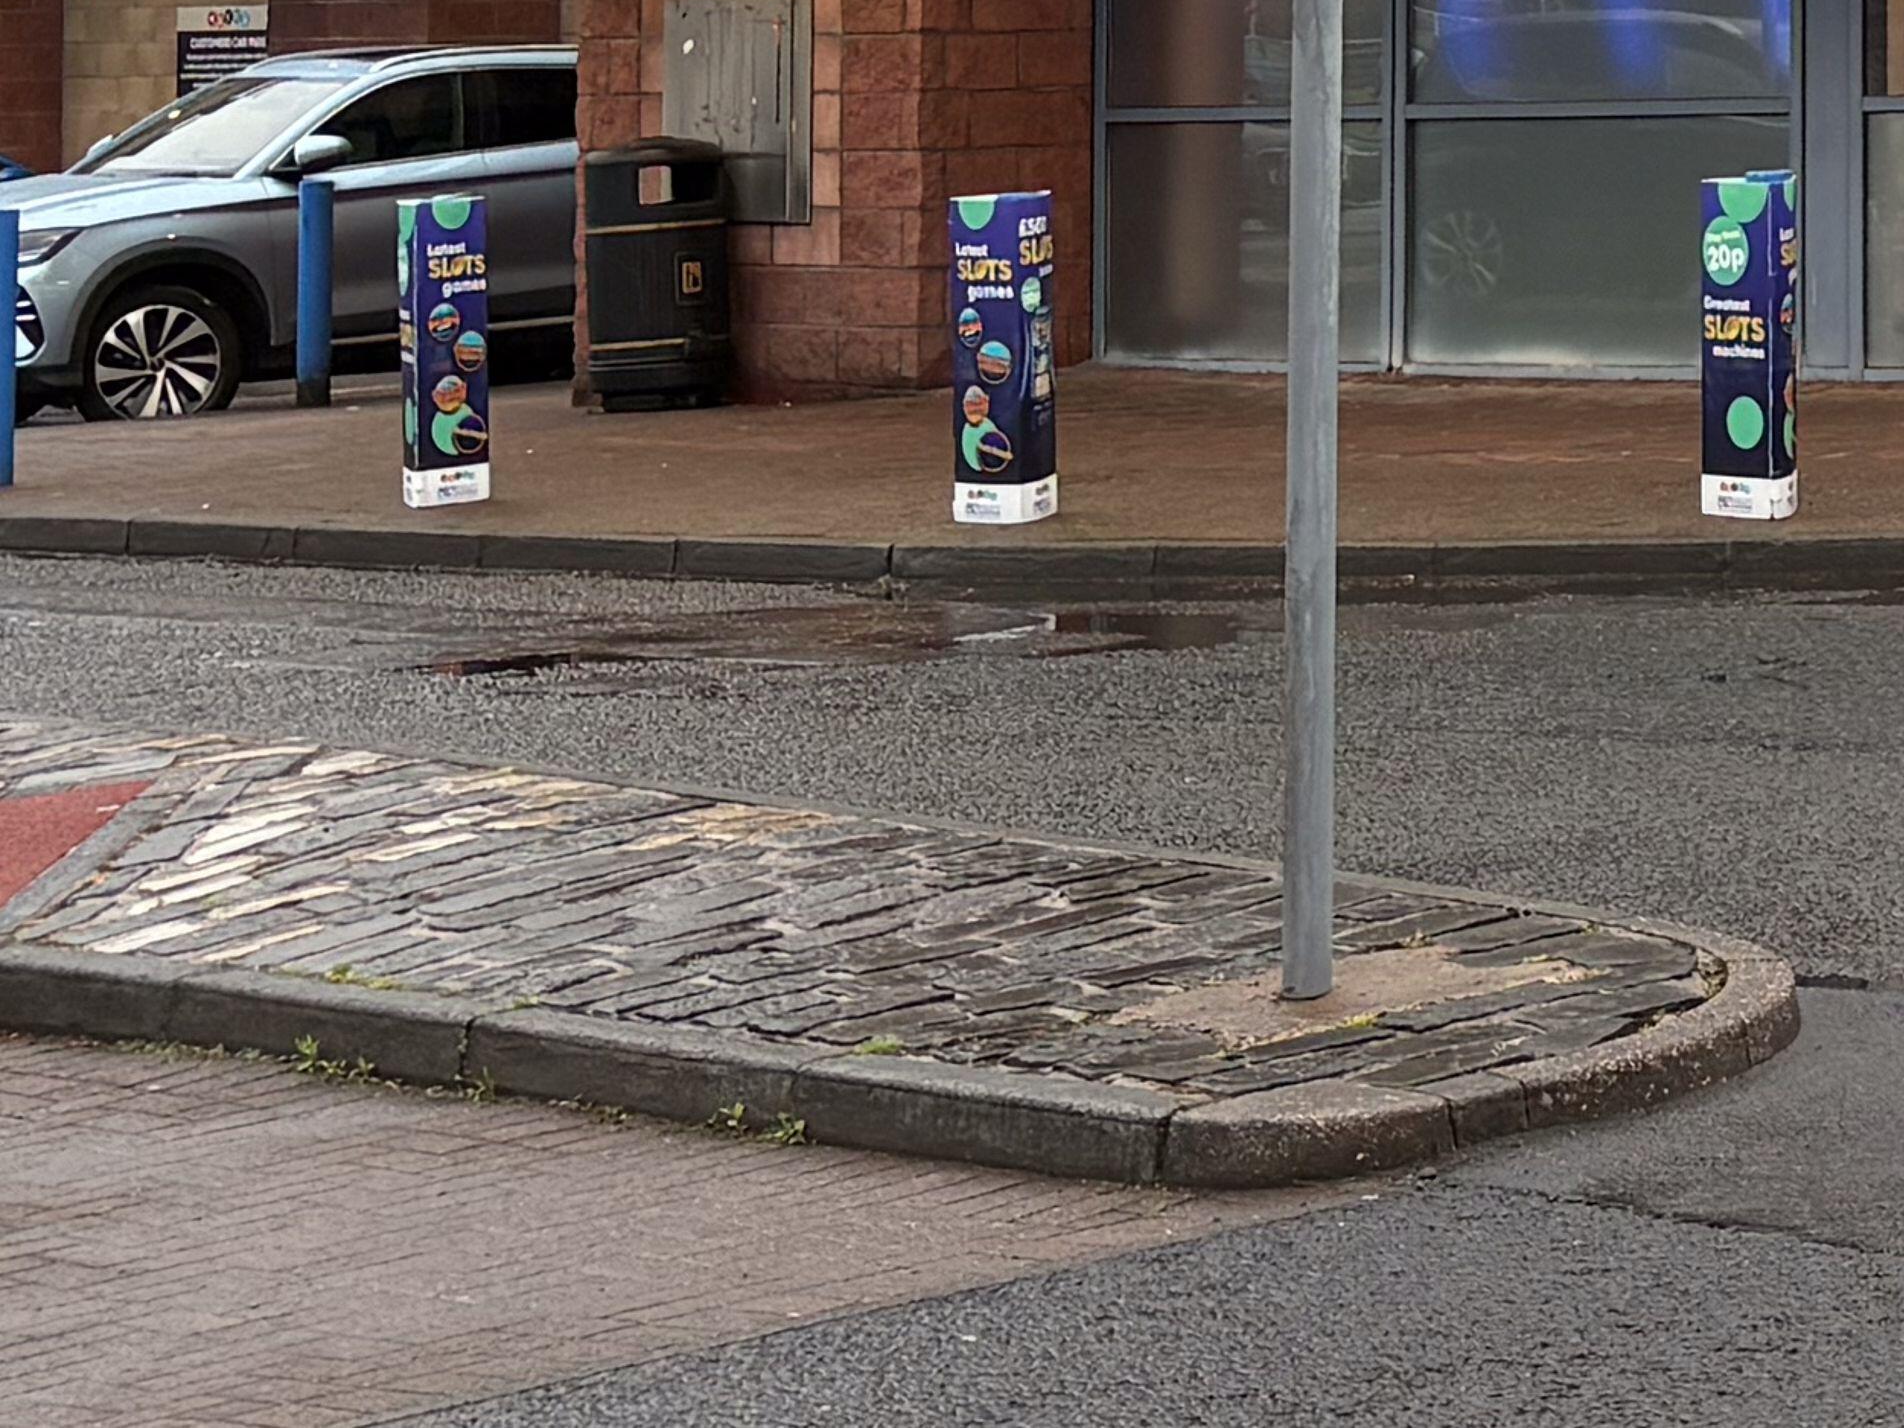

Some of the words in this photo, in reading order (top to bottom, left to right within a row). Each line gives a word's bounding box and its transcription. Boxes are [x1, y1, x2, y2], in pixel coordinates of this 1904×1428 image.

[427, 254, 488, 280] SLOTS
[956, 258, 1013, 282] SLOTS
[1707, 244, 1745, 273] 20p
[1703, 314, 1766, 343] SLOTS
